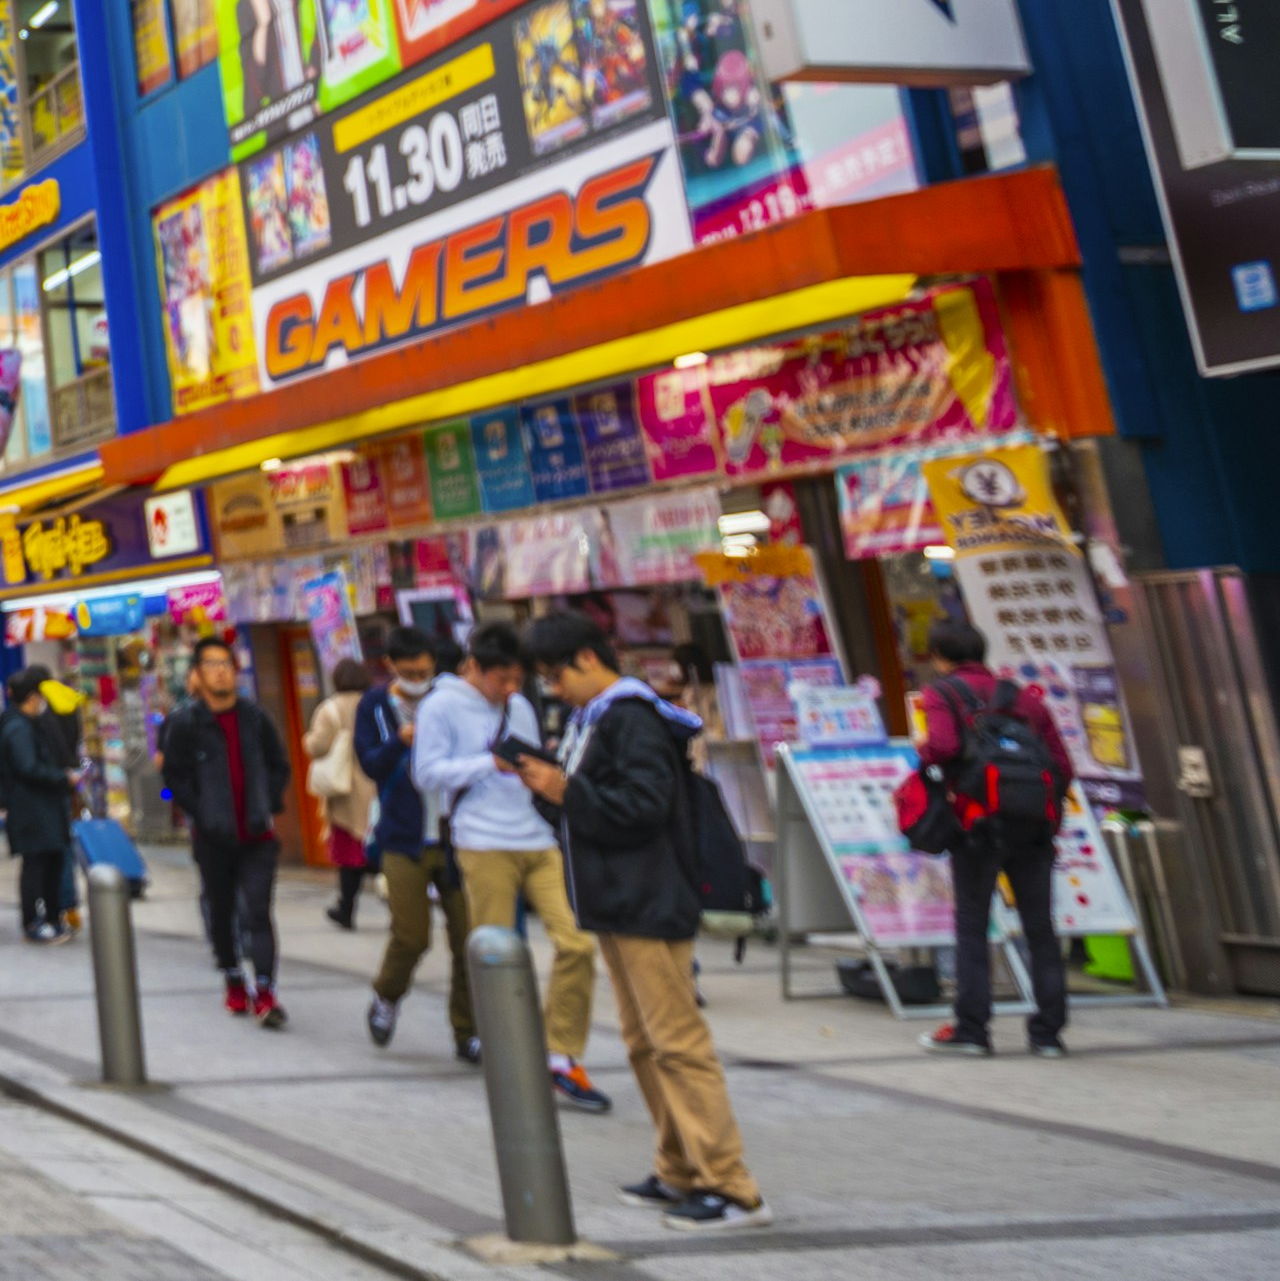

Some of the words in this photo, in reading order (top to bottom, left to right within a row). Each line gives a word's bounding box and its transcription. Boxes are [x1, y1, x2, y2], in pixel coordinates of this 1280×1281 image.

[344, 111, 463, 227] 11.30
[460, 94, 502, 137] 同日
[266, 146, 670, 382] GAMERS
